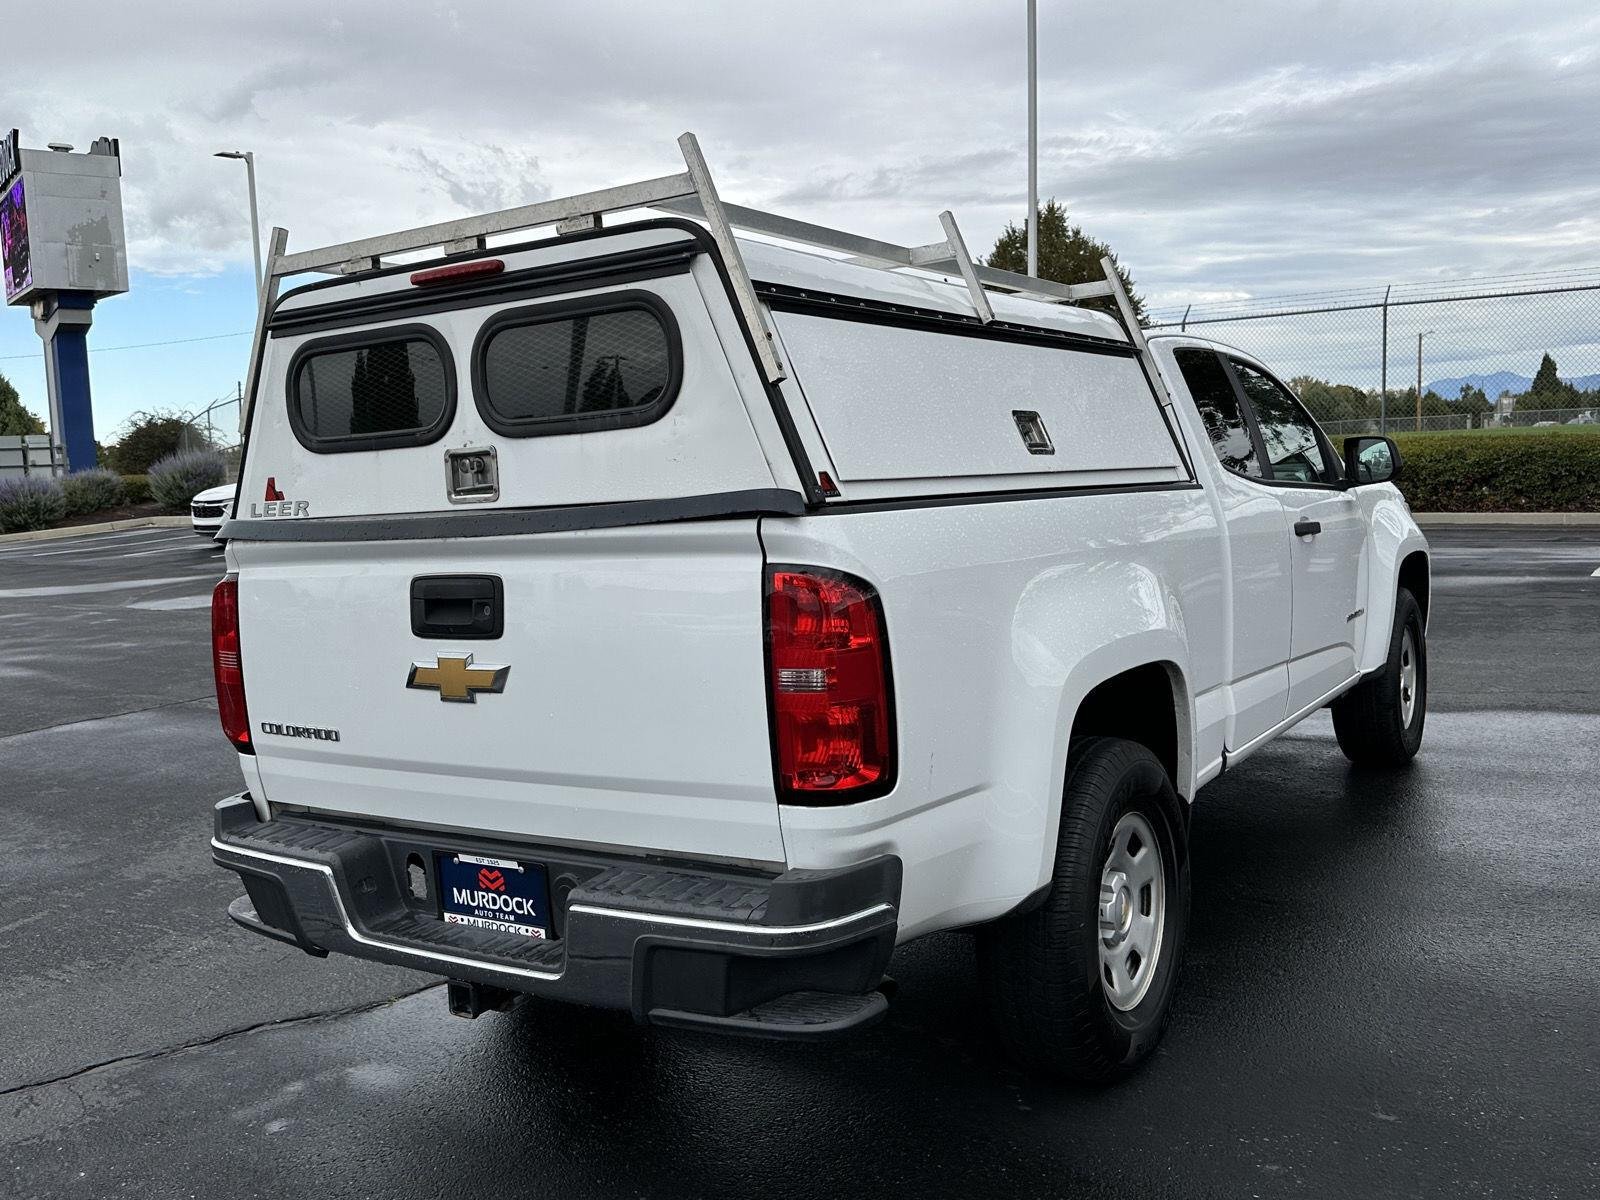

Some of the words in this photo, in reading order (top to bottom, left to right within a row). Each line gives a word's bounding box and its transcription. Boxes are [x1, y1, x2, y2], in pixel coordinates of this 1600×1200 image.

[250, 500, 310, 518] LEER
[261, 722, 340, 742] COLORADO
[453, 887, 536, 916] MURDOCK
[474, 909, 493, 918] AUTO
[496, 912, 515, 921] TEAM
[467, 918, 521, 935] MURDOCK
